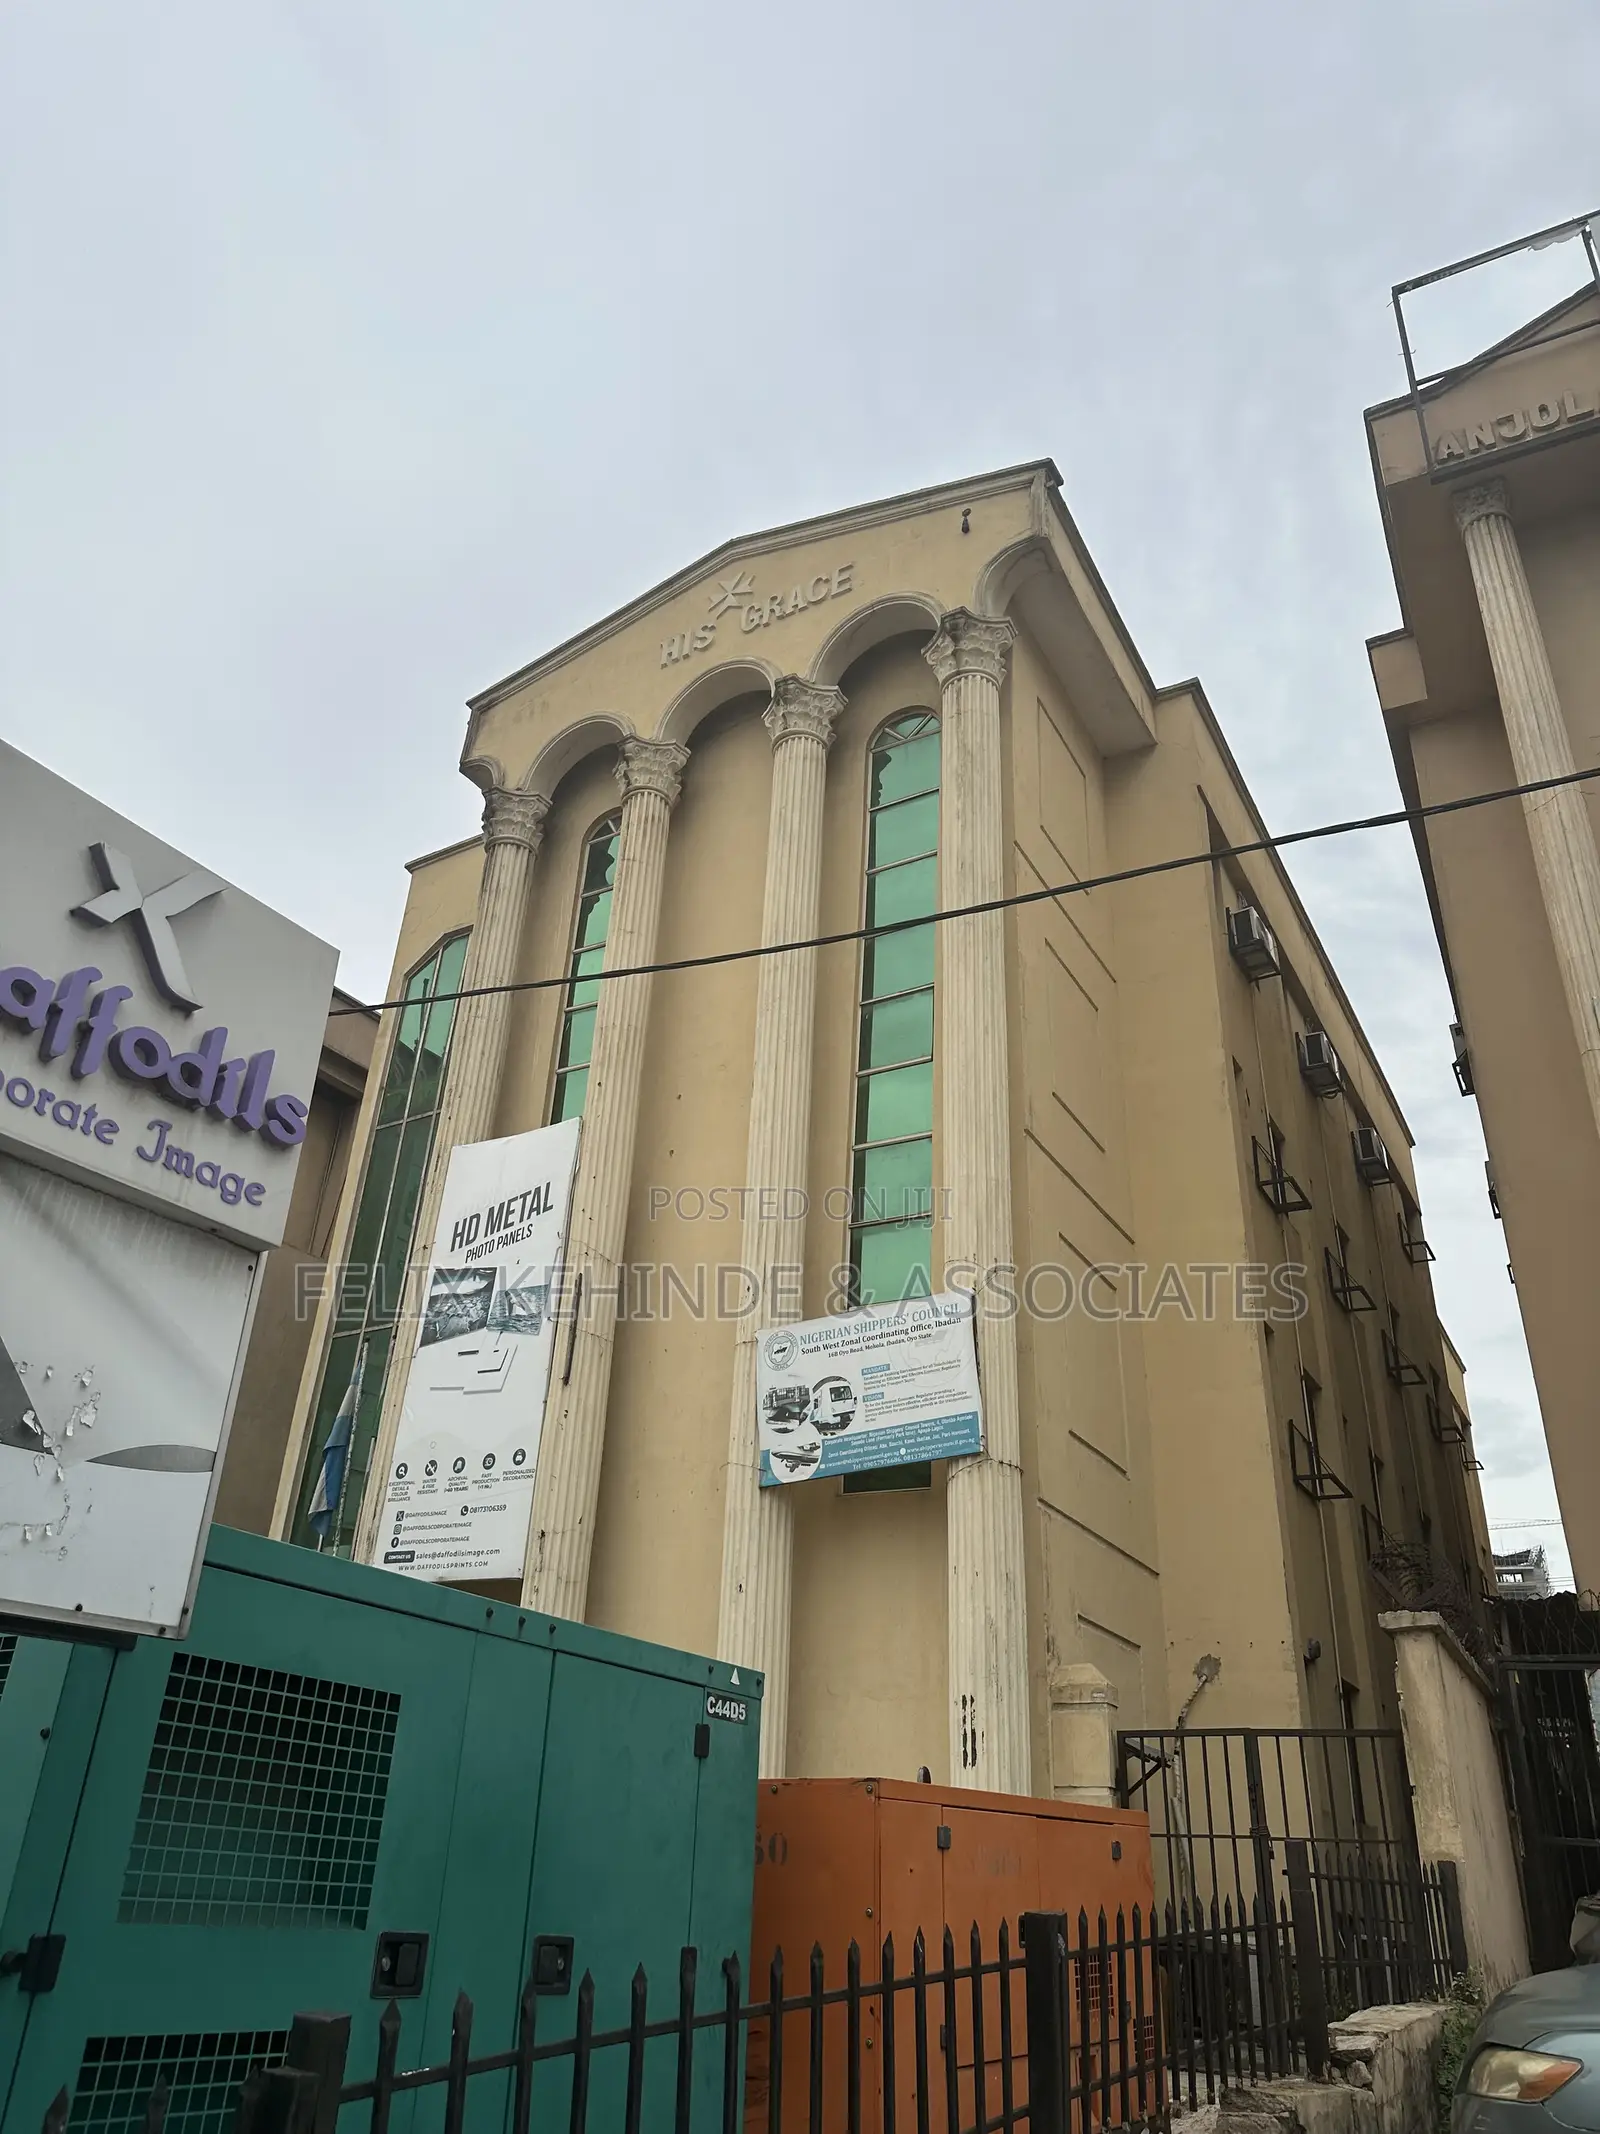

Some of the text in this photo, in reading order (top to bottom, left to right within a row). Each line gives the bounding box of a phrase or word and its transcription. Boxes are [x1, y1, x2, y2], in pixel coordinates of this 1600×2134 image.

[1435, 387, 1600, 461] ANJOL
[660, 562, 854, 669] HIS GRACE
[0, 1068, 120, 1144] orate
[450, 1181, 553, 1252] HD METAL
[465, 1223, 533, 1263] PHOTO PANELS
[800, 1303, 961, 1345] NIGERIAN SHIPPERS' COUNCIL
[801, 1317, 961, 1355] South West Zonal Coordinating Office, Ibadan
[416, 1549, 500, 1560] sales@daffodilsimage.com
[707, 1696, 746, 1720] C44D5
